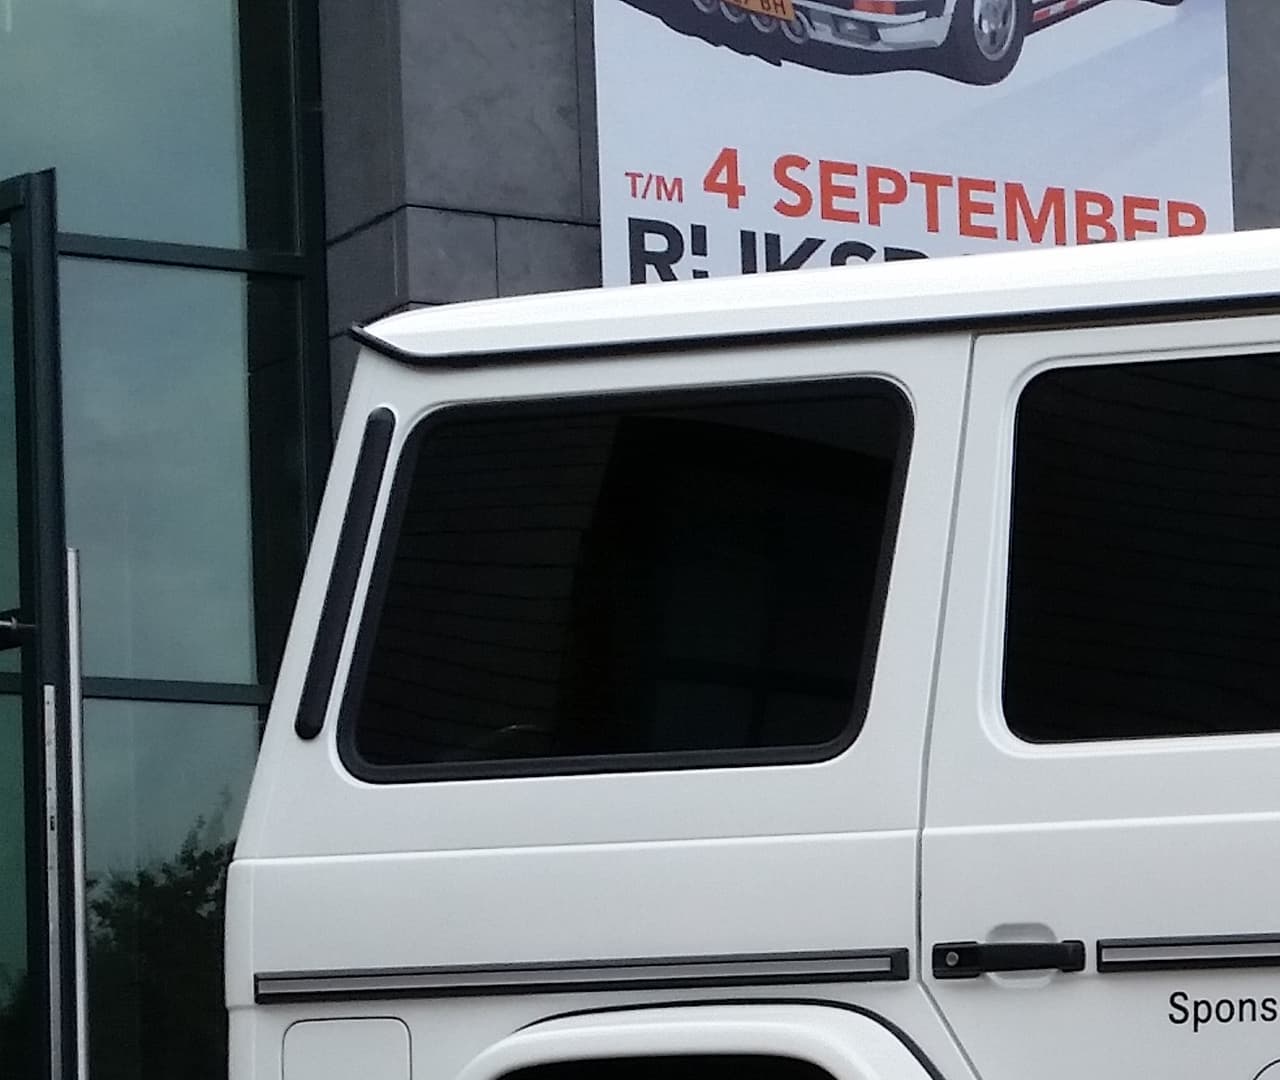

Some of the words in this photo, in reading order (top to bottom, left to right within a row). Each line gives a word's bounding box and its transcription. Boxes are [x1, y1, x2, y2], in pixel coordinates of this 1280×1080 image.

[625, 171, 683, 202] T/M
[703, 147, 746, 209] 4
[773, 154, 1207, 246] SEPTEMBER
